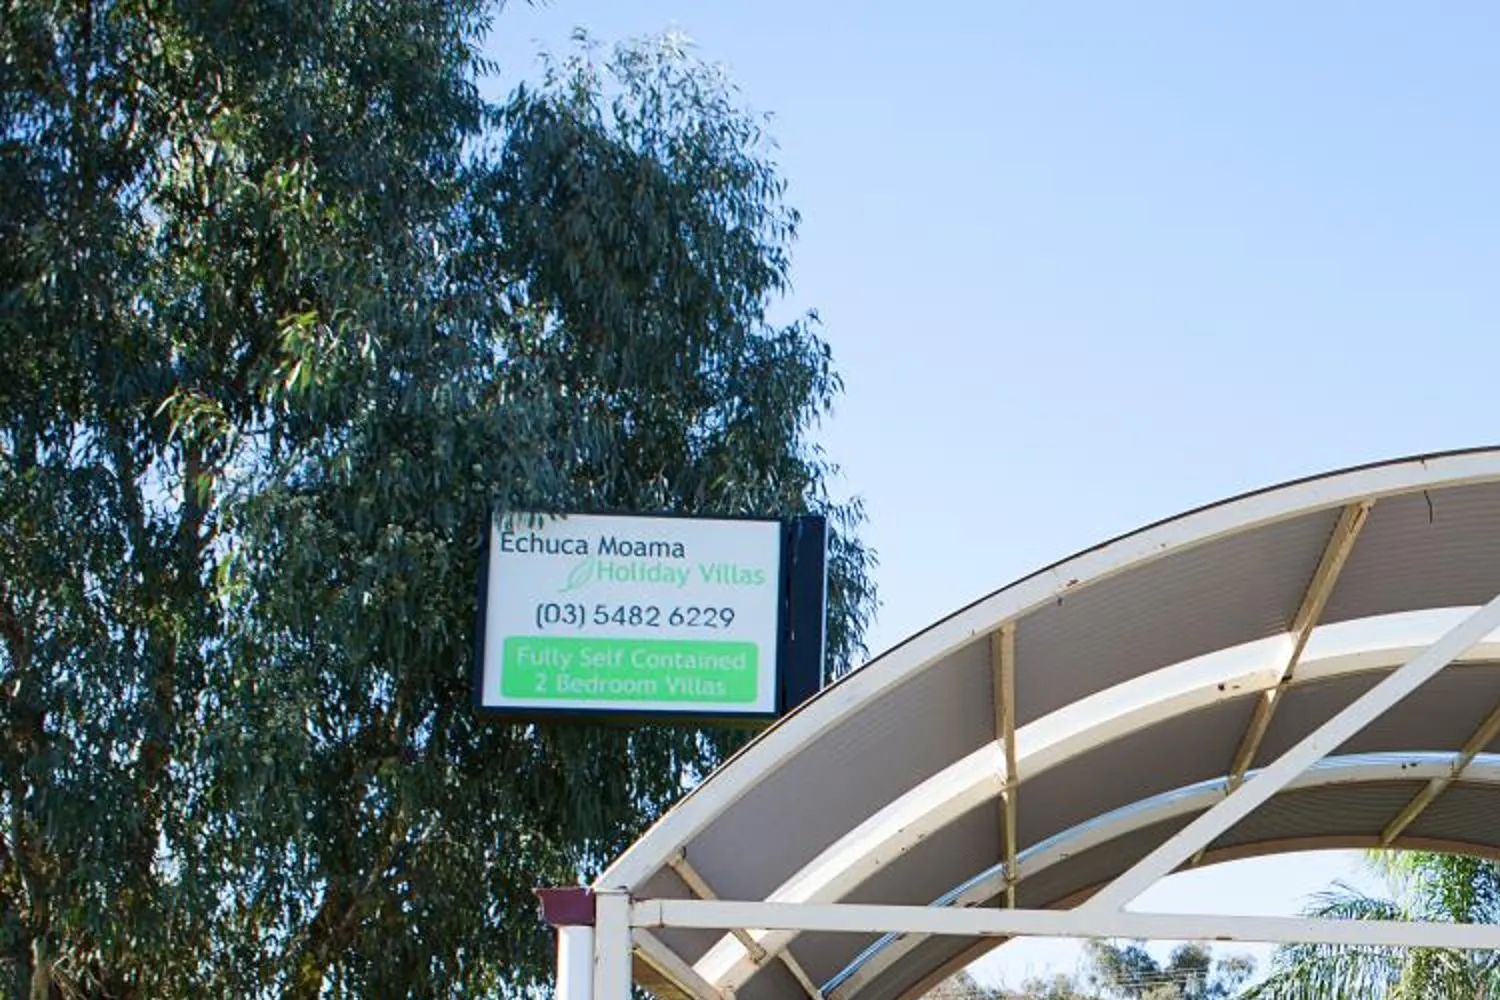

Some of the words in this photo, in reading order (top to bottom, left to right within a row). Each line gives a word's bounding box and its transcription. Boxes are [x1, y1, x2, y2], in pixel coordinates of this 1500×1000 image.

[500, 530, 589, 555] Echuca
[597, 535, 685, 558] Moama
[597, 560, 691, 588] Holiday
[698, 563, 766, 586] Villas
[536, 602, 585, 629] (03)
[593, 604, 660, 627] 5482
[668, 606, 735, 629] 6229
[516, 646, 574, 671] Fully
[579, 647, 624, 668] Self
[631, 649, 747, 671] Contained
[535, 673, 548, 692] 2
[556, 673, 657, 695] Bedroom
[665, 675, 726, 697] Villas
